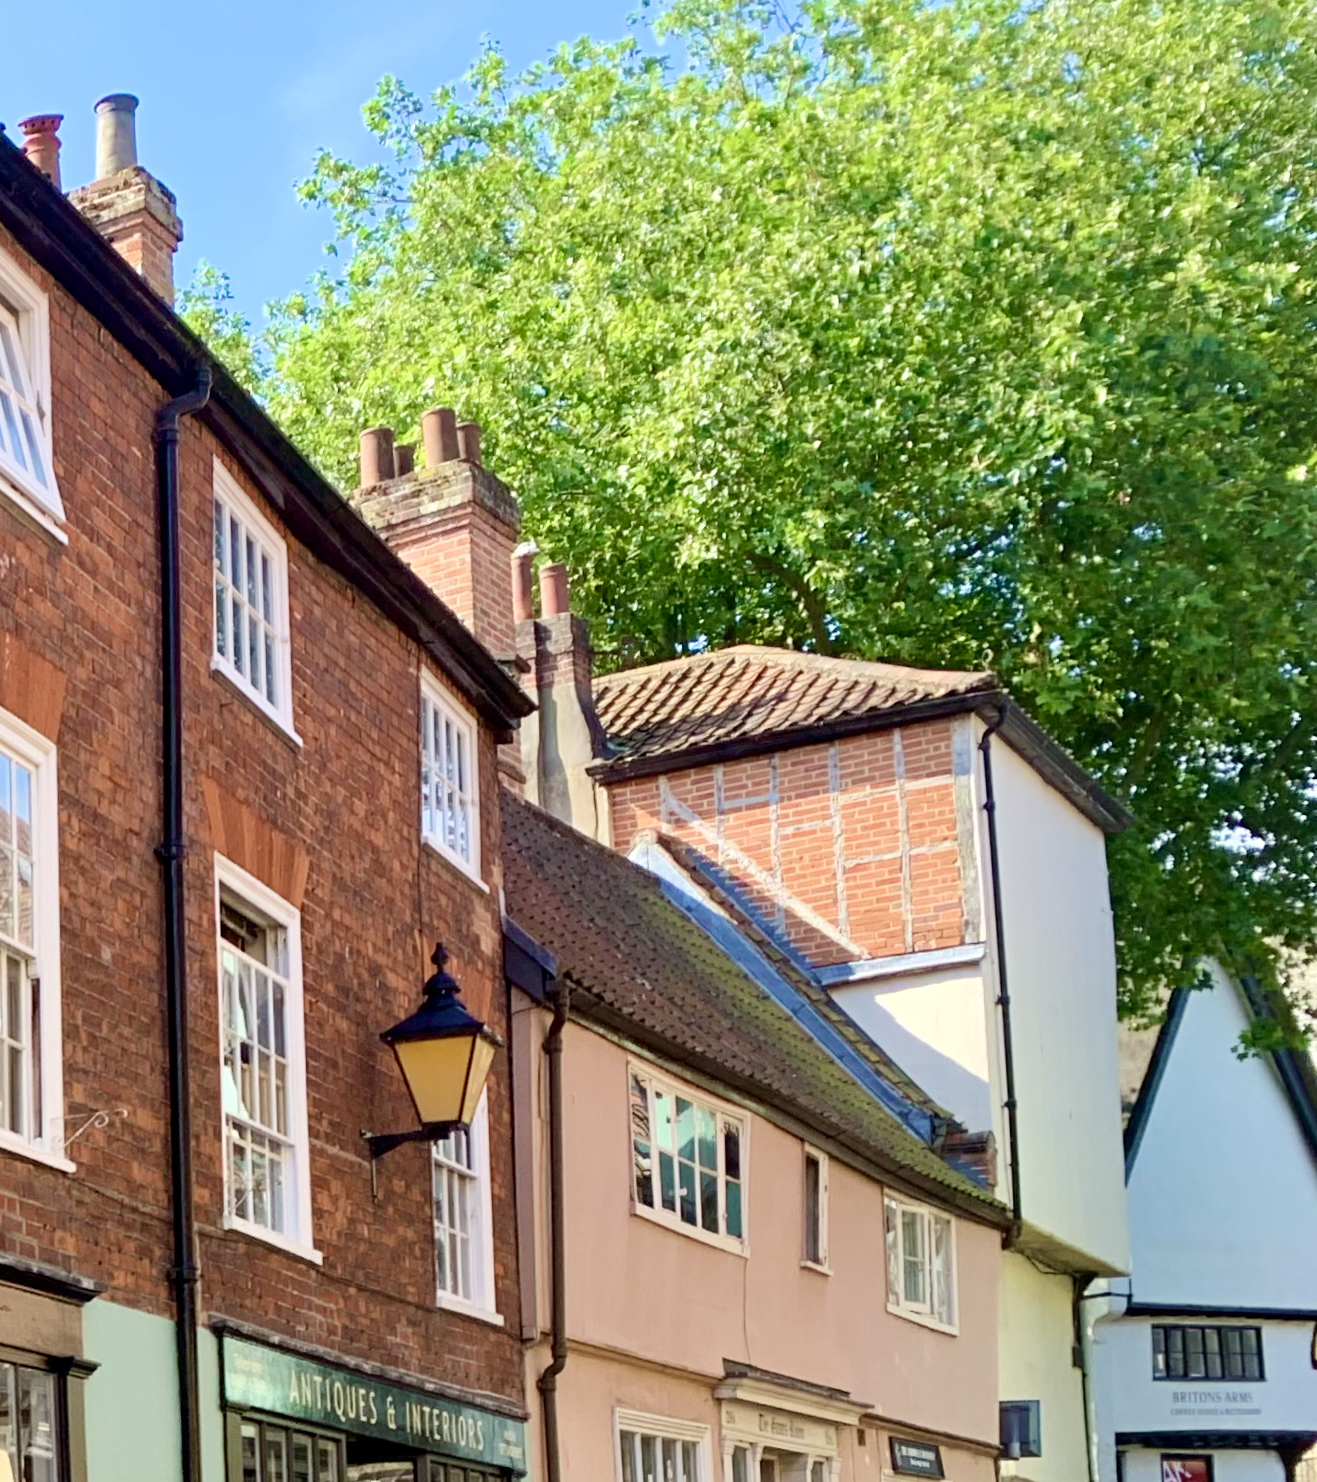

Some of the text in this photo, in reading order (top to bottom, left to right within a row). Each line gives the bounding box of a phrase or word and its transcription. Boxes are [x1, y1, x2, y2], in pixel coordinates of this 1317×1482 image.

[290, 1370, 484, 1450] ANTIQUES & INTERIORS
[1172, 1391, 1253, 1403] BRITONS ARMS
